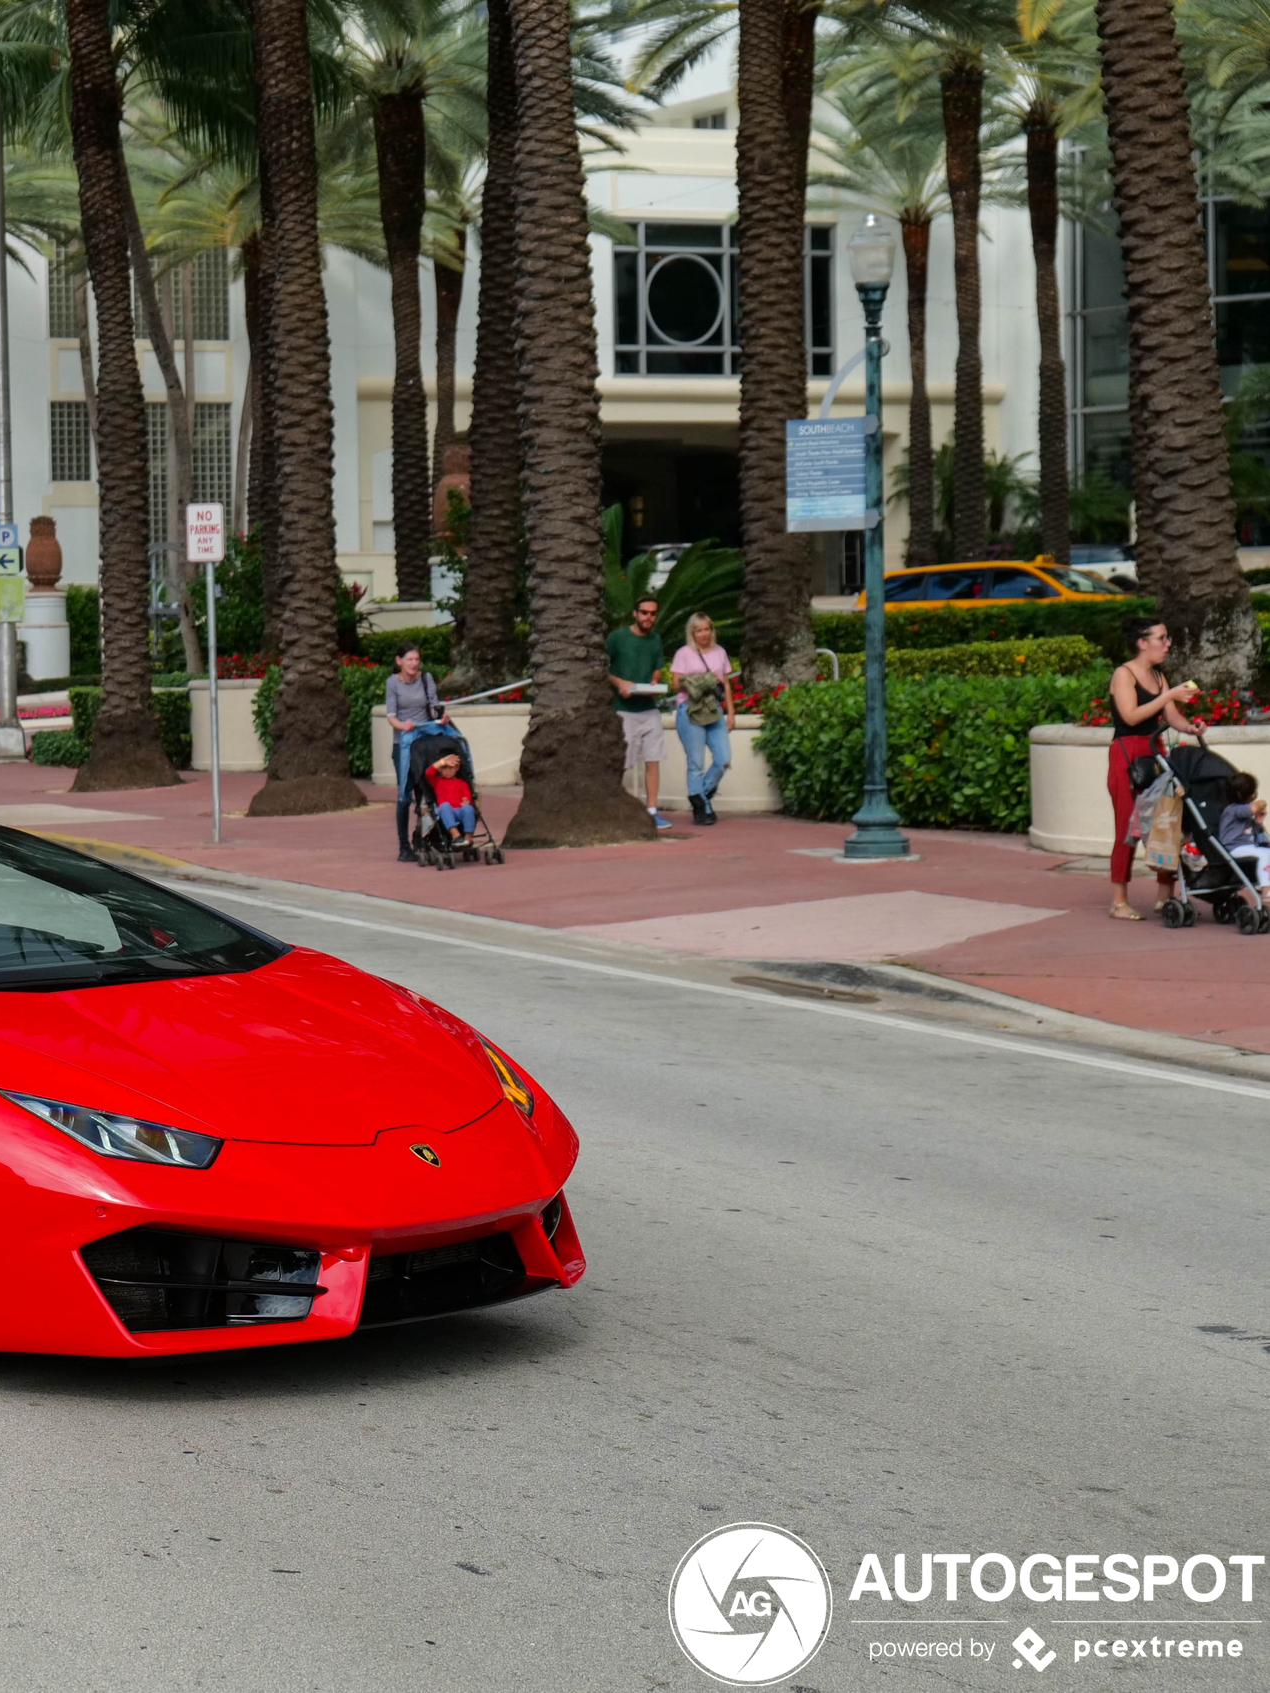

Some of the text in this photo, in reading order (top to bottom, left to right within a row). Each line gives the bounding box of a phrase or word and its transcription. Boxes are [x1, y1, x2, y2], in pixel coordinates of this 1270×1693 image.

[197, 510, 212, 521] NO
[190, 524, 220, 534] PARKING
[2, 531, 10, 542] P
[197, 546, 214, 554] TIME
